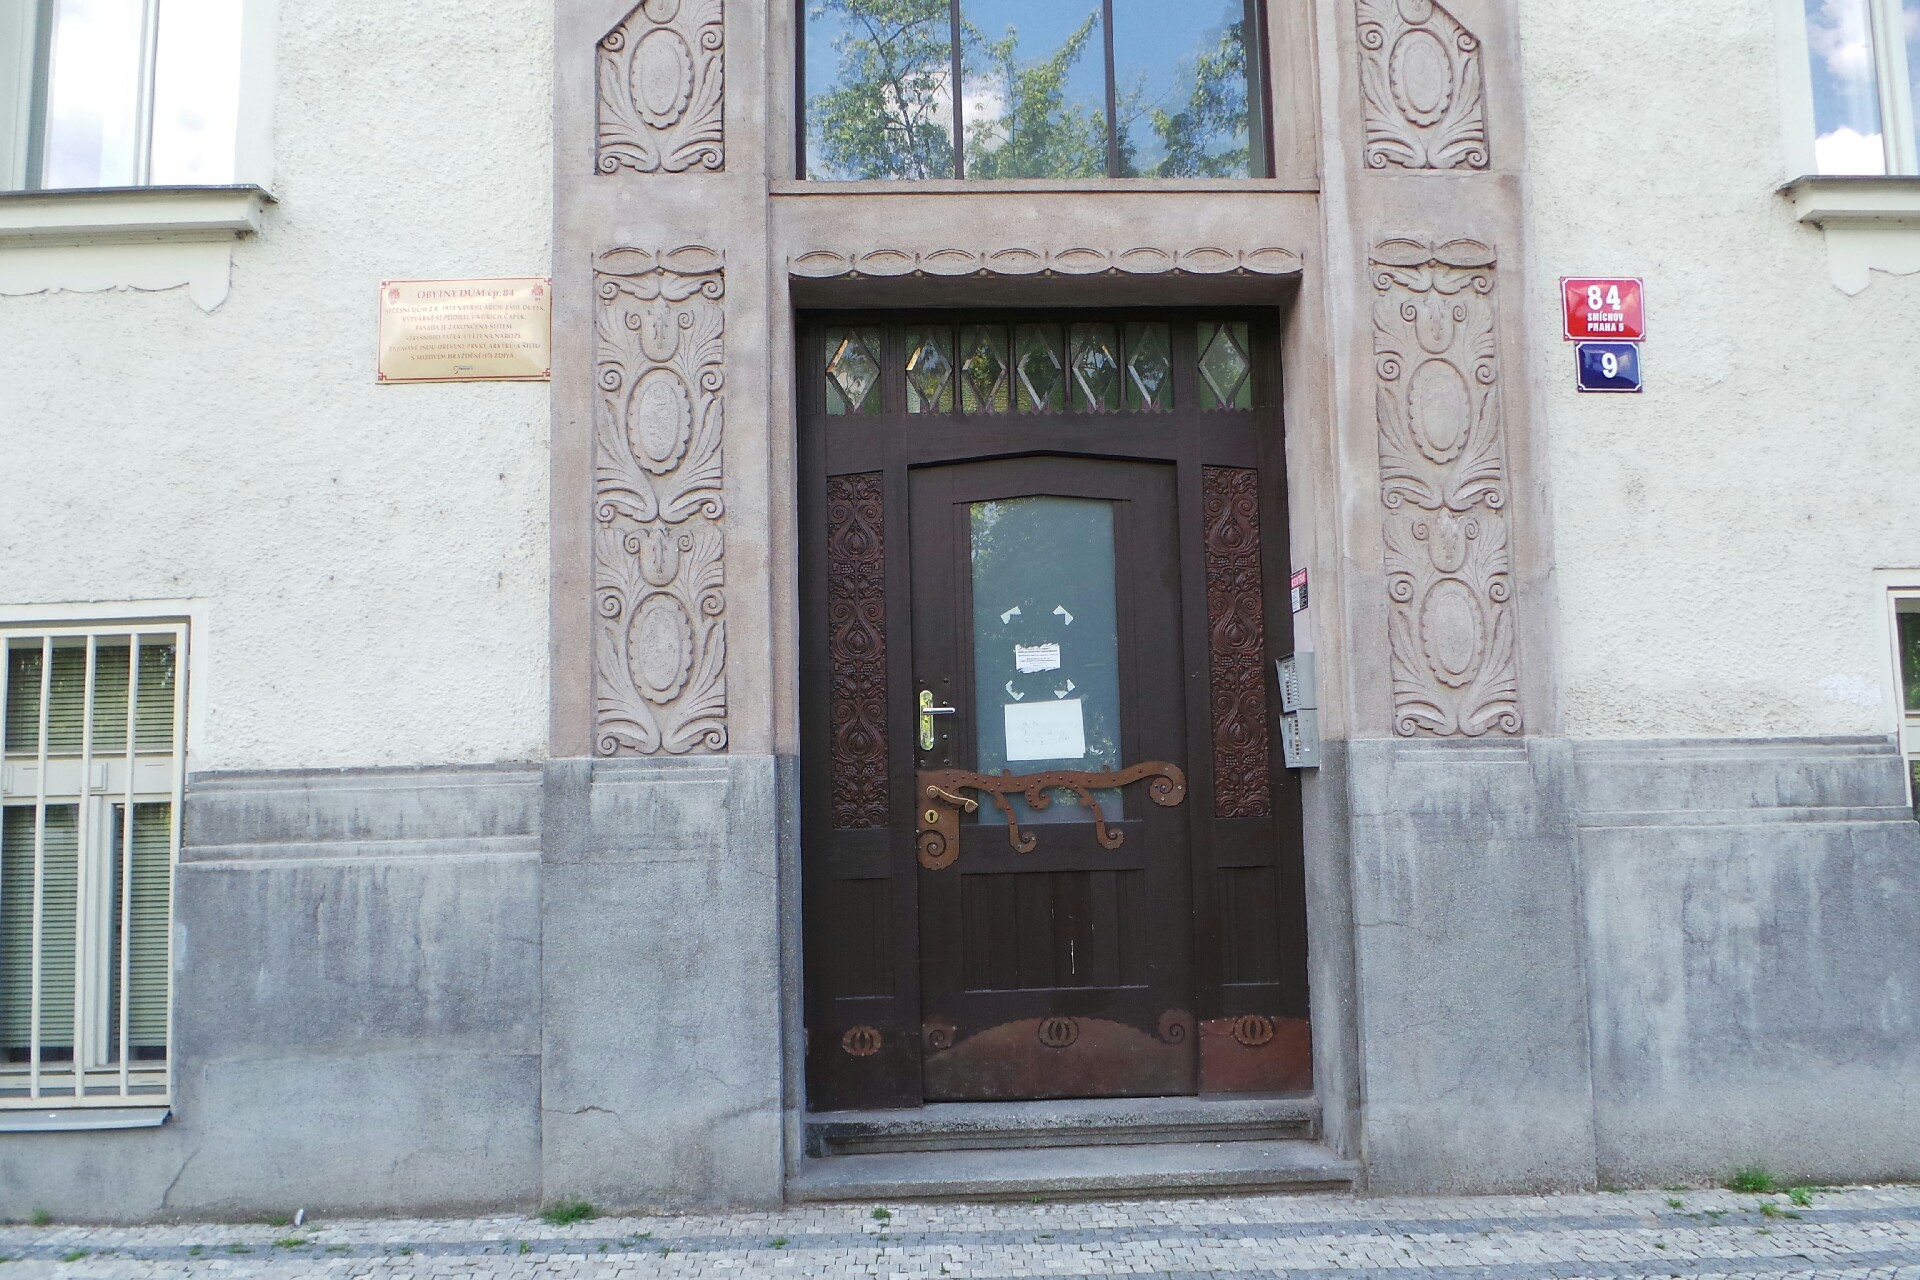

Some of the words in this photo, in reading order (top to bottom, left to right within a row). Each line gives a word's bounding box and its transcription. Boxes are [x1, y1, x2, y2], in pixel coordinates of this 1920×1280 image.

[1588, 285, 1620, 310] 84
[1587, 311, 1623, 322] SMÍCHOV
[1587, 323, 1617, 332] PRAHA
[1618, 323, 1624, 332] 5
[1602, 353, 1617, 378] 9
